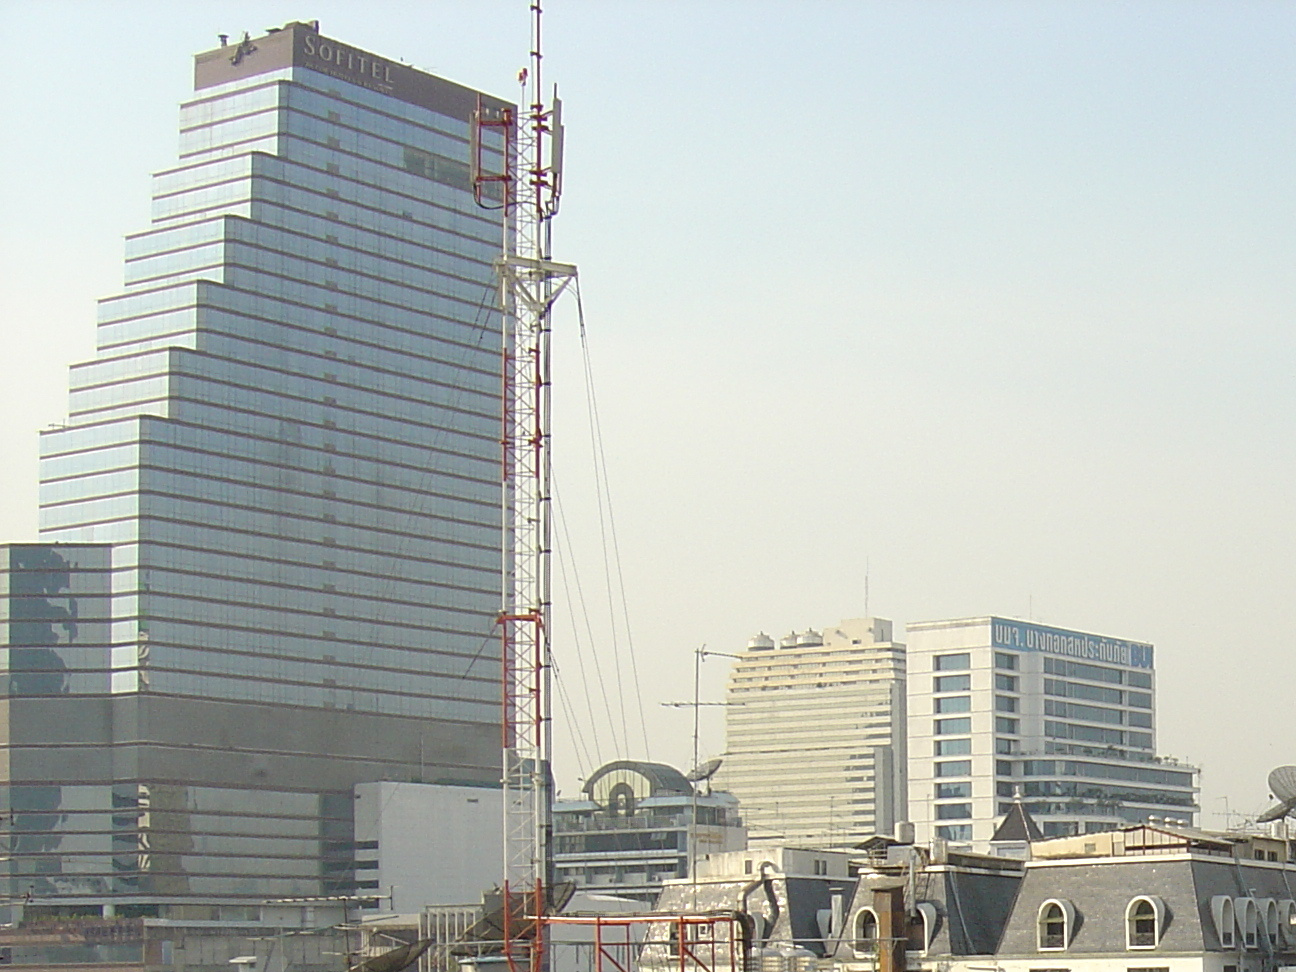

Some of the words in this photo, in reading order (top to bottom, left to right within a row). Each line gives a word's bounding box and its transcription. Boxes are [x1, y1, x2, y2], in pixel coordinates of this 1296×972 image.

[304, 35, 394, 83] SOFITEL
[995, 624, 1024, 647] บมจ.
[1026, 630, 1128, 664] บางกอกสหประกันภัย
